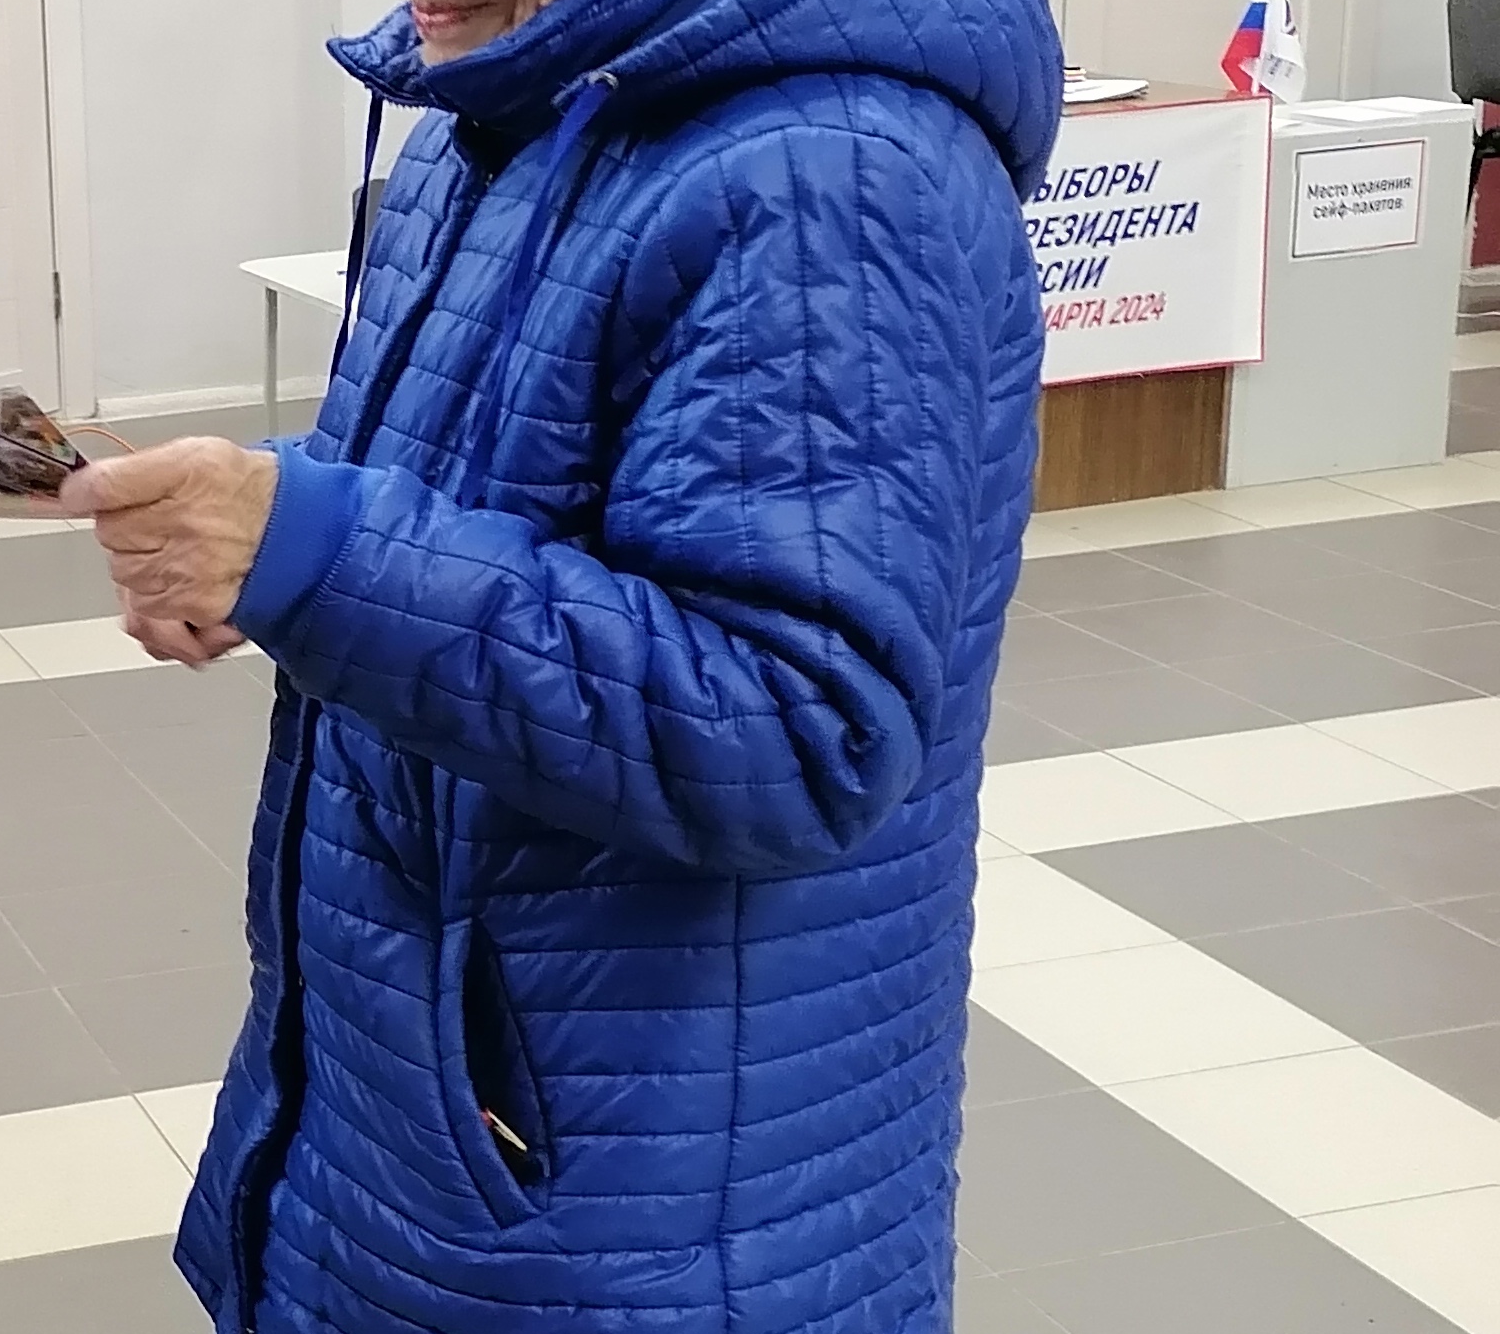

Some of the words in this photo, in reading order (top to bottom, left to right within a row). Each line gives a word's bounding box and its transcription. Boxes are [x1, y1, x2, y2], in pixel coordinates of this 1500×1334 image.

[1032, 159, 1162, 204] ЫБОРЫ
[1307, 183, 1349, 200] Место
[1351, 176, 1413, 199] хранения
[1025, 200, 1200, 249] РЕЗИДЕНТА
[1312, 197, 1404, 220] сейф-пакетов
[1044, 297, 1106, 332] АРТА
[1108, 290, 1167, 327] 2024
